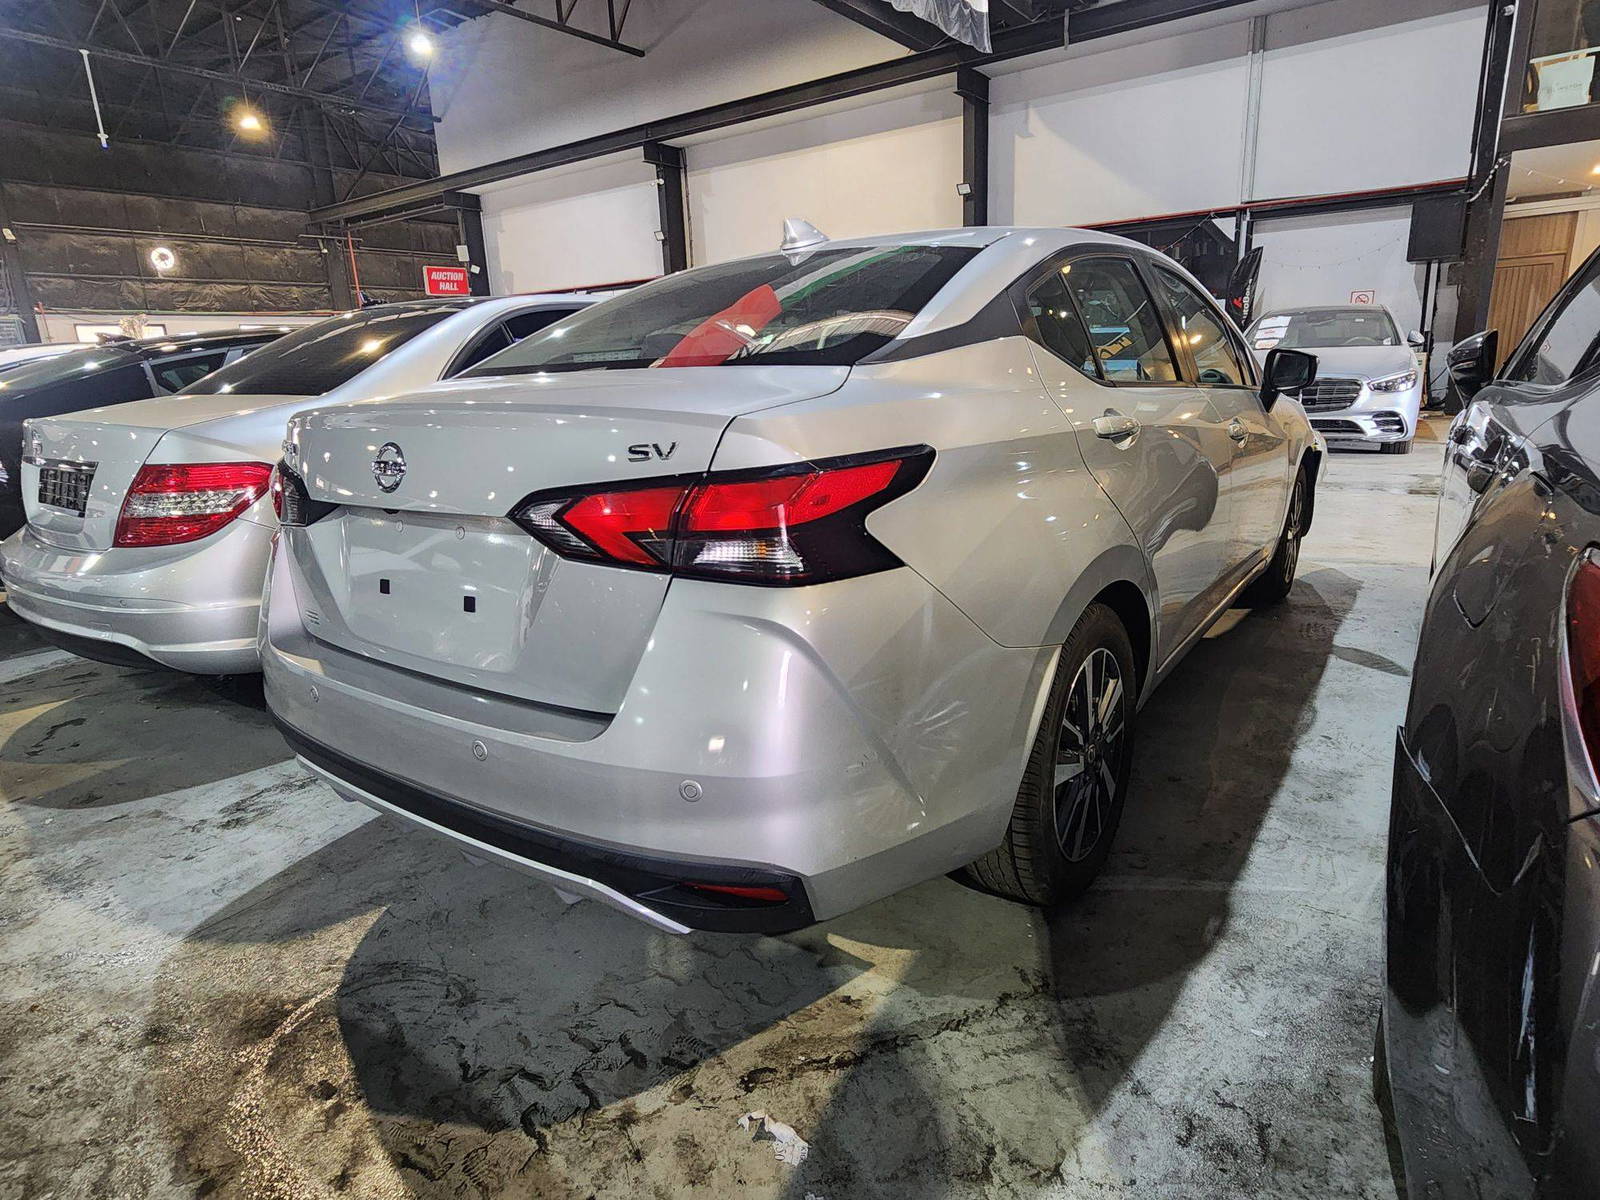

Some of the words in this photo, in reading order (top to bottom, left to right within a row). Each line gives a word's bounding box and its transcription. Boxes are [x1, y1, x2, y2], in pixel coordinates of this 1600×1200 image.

[431, 271, 464, 281] AUCTION
[439, 281, 459, 291] HALL
[627, 441, 677, 462] SV
